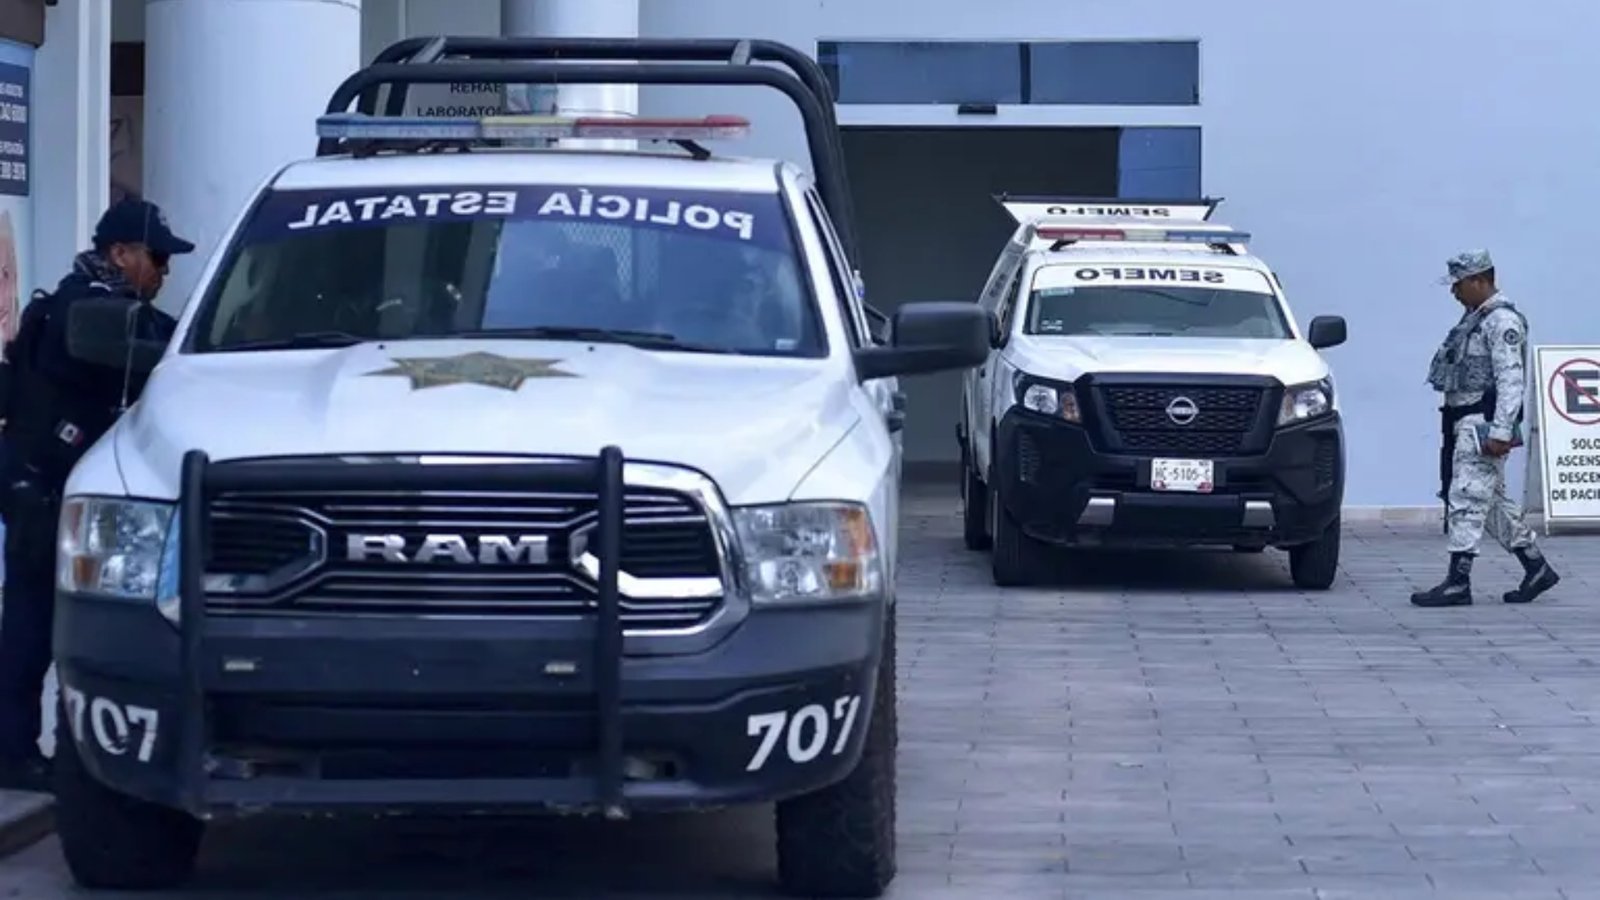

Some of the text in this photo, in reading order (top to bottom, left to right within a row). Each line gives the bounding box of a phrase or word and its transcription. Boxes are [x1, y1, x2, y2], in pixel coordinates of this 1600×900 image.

[1552, 489, 1567, 501] DE
[346, 533, 549, 564] RAM
[63, 684, 158, 763] 707
[746, 695, 860, 772] 707
